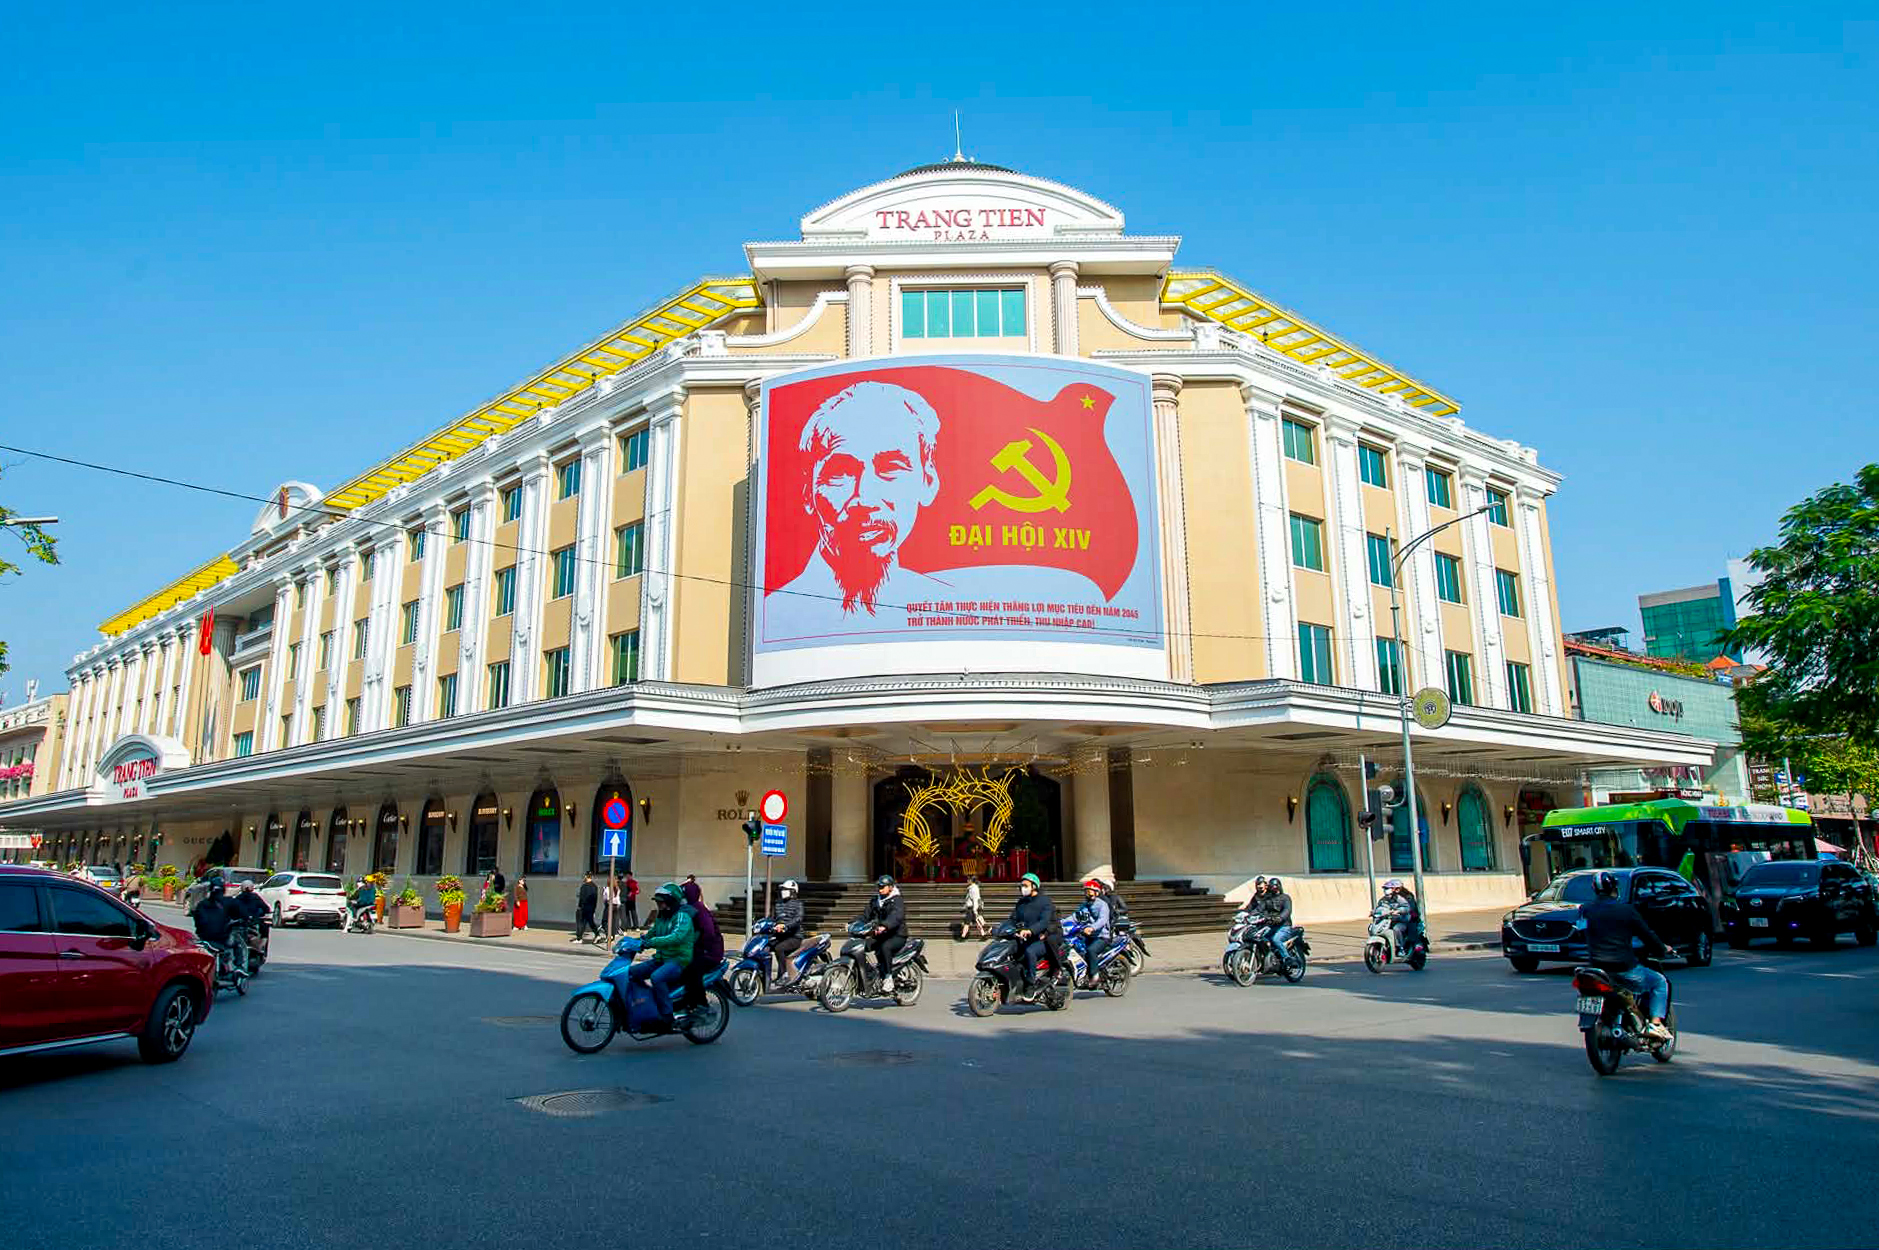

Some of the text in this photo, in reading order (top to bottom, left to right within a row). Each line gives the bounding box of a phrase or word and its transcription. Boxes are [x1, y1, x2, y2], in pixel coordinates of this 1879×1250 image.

[876, 208, 1046, 231] TRANG TIEN
[934, 230, 989, 241] PLAZA
[949, 520, 1091, 551] ĐẠI HỘI XIV
[907, 601, 931, 613] QUYẾT
[935, 601, 954, 612] TÂM
[956, 601, 977, 613] THỰC
[980, 600, 1000, 613] HIỆN
[1003, 600, 1030, 612] THẮNG
[1032, 602, 1044, 613] LỢI
[1047, 603, 1065, 615] MỤC
[1067, 603, 1084, 614] TIÊU
[1103, 606, 1120, 618] NĂM
[1121, 608, 1138, 619] 2045
[907, 613, 923, 626] TRỞ
[925, 615, 954, 626] THÀNH
[956, 615, 979, 626] NƯỚC
[982, 614, 1003, 626] PHÁT
[1035, 616, 1050, 626] THU
[1574, 826, 1593, 836] SMART
